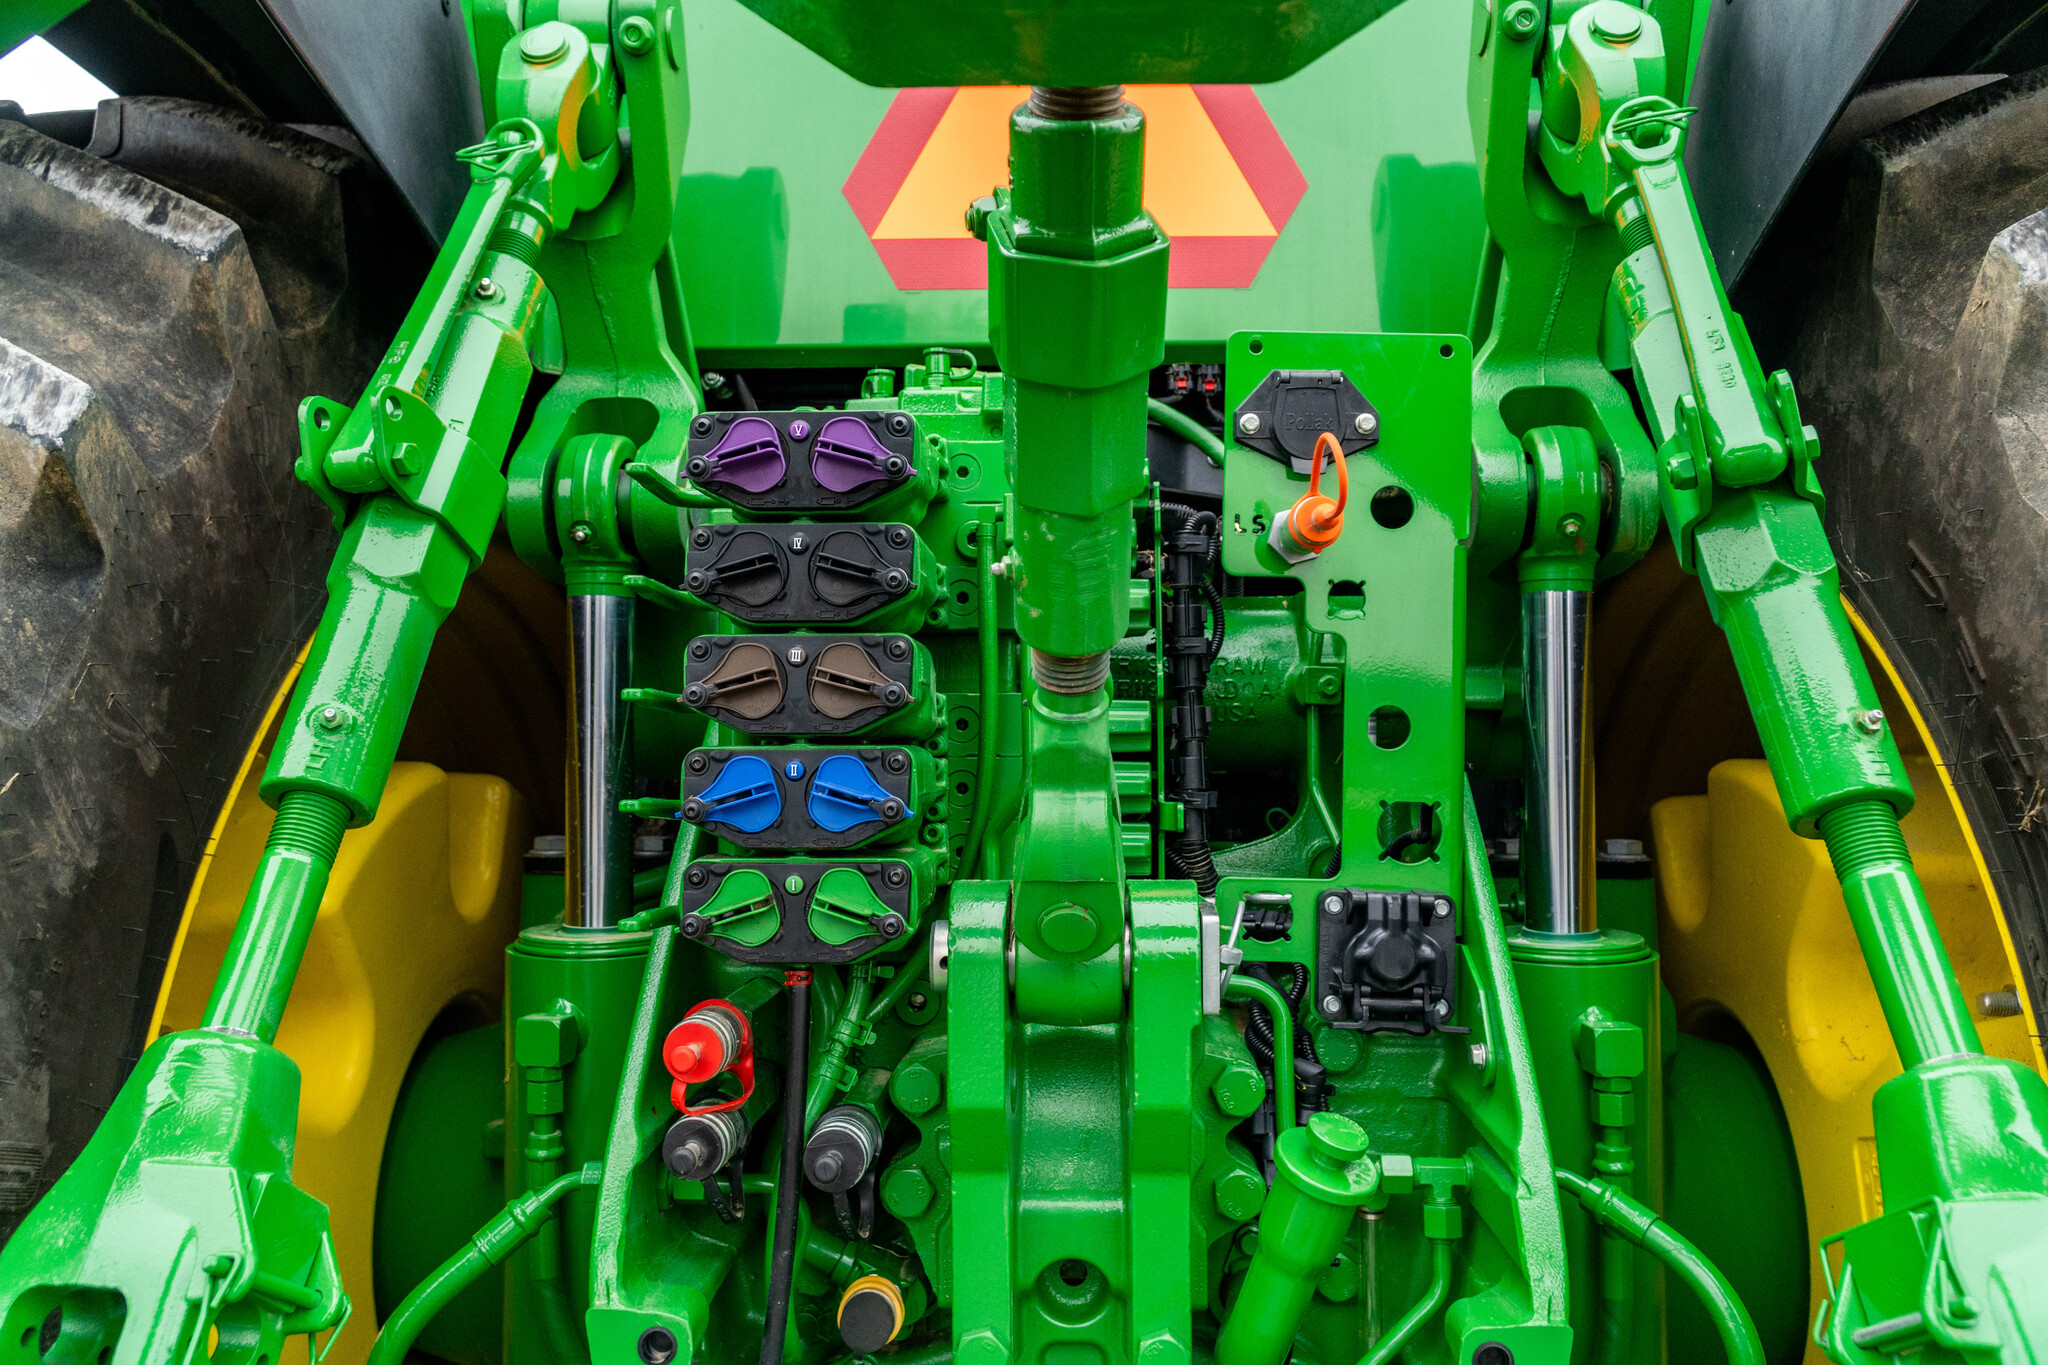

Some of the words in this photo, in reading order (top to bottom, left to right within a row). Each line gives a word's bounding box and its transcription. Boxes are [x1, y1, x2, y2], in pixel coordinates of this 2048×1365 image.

[793, 424, 804, 436] V
[1285, 412, 1335, 432] Pollak
[1234, 513, 1266, 534] LS
[793, 537, 802, 549] IV
[790, 649, 802, 662] III
[1213, 657, 1267, 675] RAW
[1215, 702, 1257, 723] USA
[305, 742, 335, 771] LH
[790, 764, 798, 776] II
